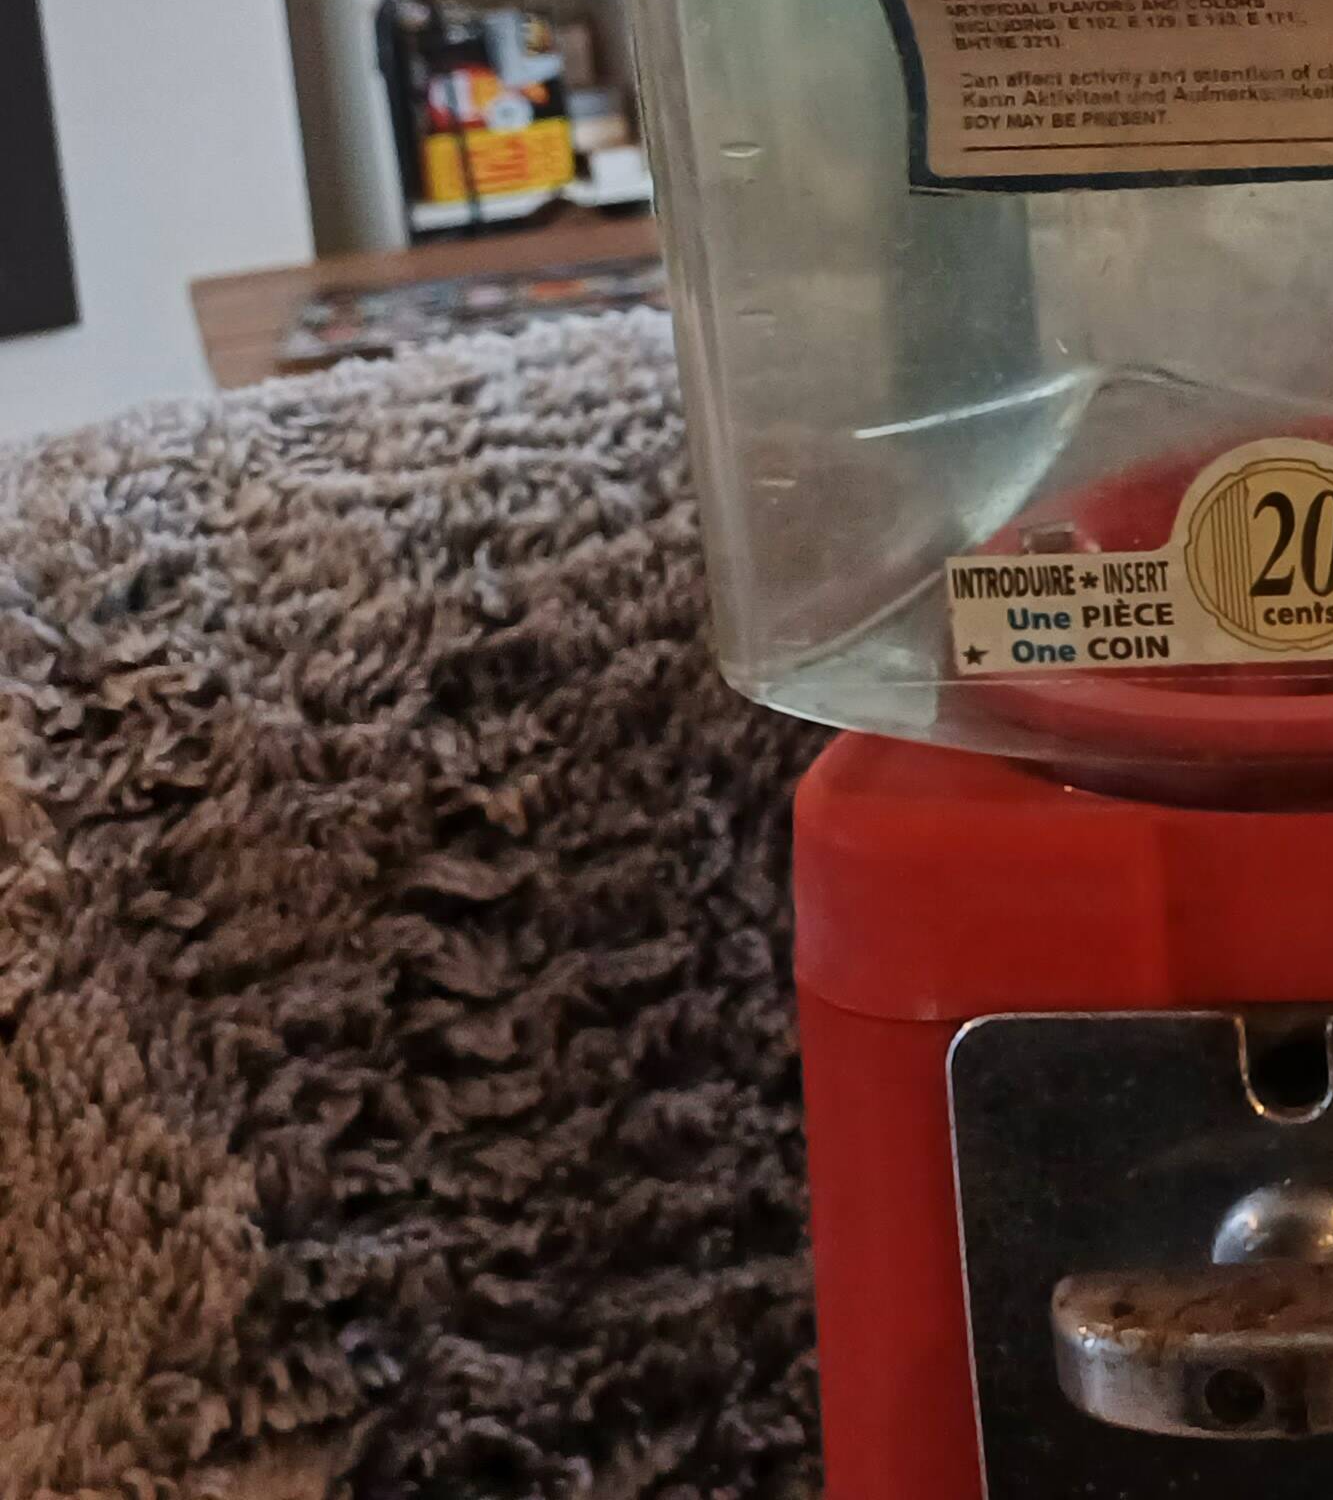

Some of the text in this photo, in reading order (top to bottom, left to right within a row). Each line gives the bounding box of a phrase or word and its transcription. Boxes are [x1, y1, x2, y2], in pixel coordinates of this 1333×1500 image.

[960, 71, 1000, 88] Can
[1069, 68, 1143, 89] activity
[1149, 67, 1187, 84] and
[1290, 62, 1312, 82] of
[961, 91, 1017, 109] Kann
[962, 113, 1001, 131] SOY
[1006, 112, 1046, 130] MAY
[1051, 111, 1077, 128] BE
[952, 560, 1169, 599] INTRODUIRE INSERT
[1007, 598, 1175, 633] Une PIÈCE
[1011, 634, 1171, 664] One COIN
